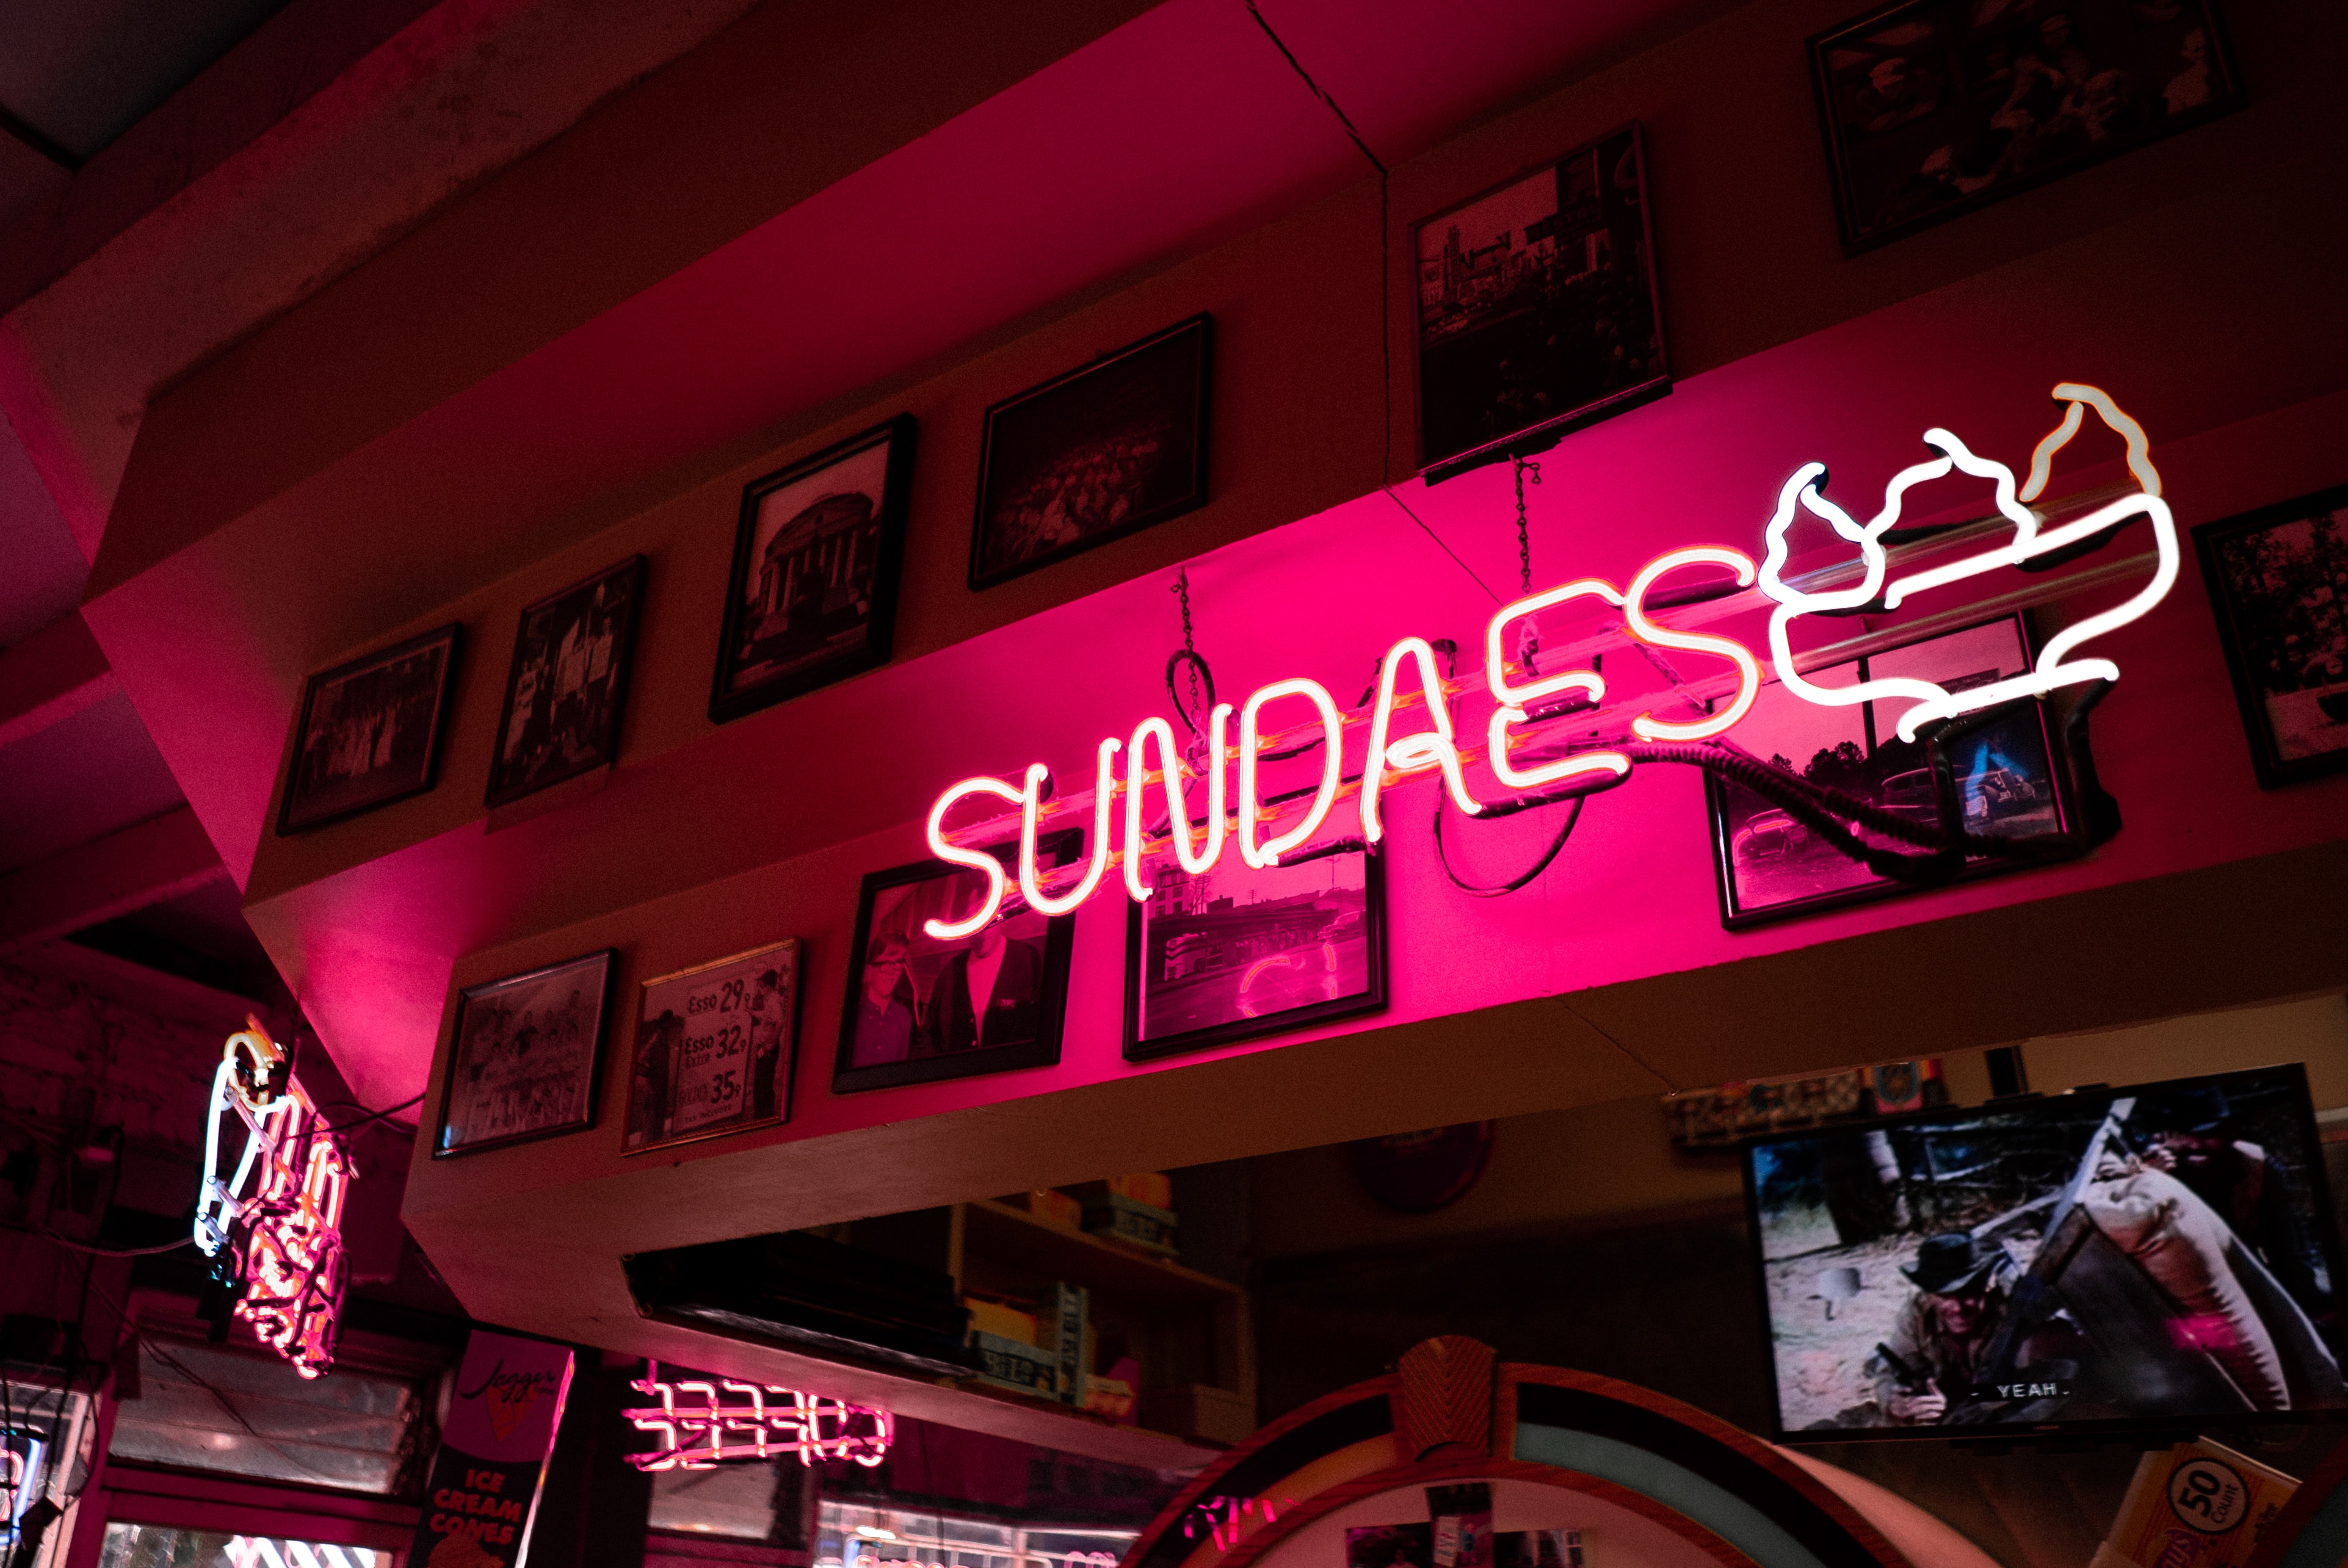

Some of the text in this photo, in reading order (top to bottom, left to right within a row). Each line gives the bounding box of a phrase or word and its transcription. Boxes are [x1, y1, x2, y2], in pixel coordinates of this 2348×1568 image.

[924, 545, 1760, 940] SUNDAES
[465, 1468, 506, 1494] ICE
[2178, 1470, 2219, 1517] 50
[433, 1487, 523, 1523] CREAM
[2211, 1483, 2239, 1524] Count
[429, 1512, 516, 1545] CONES
